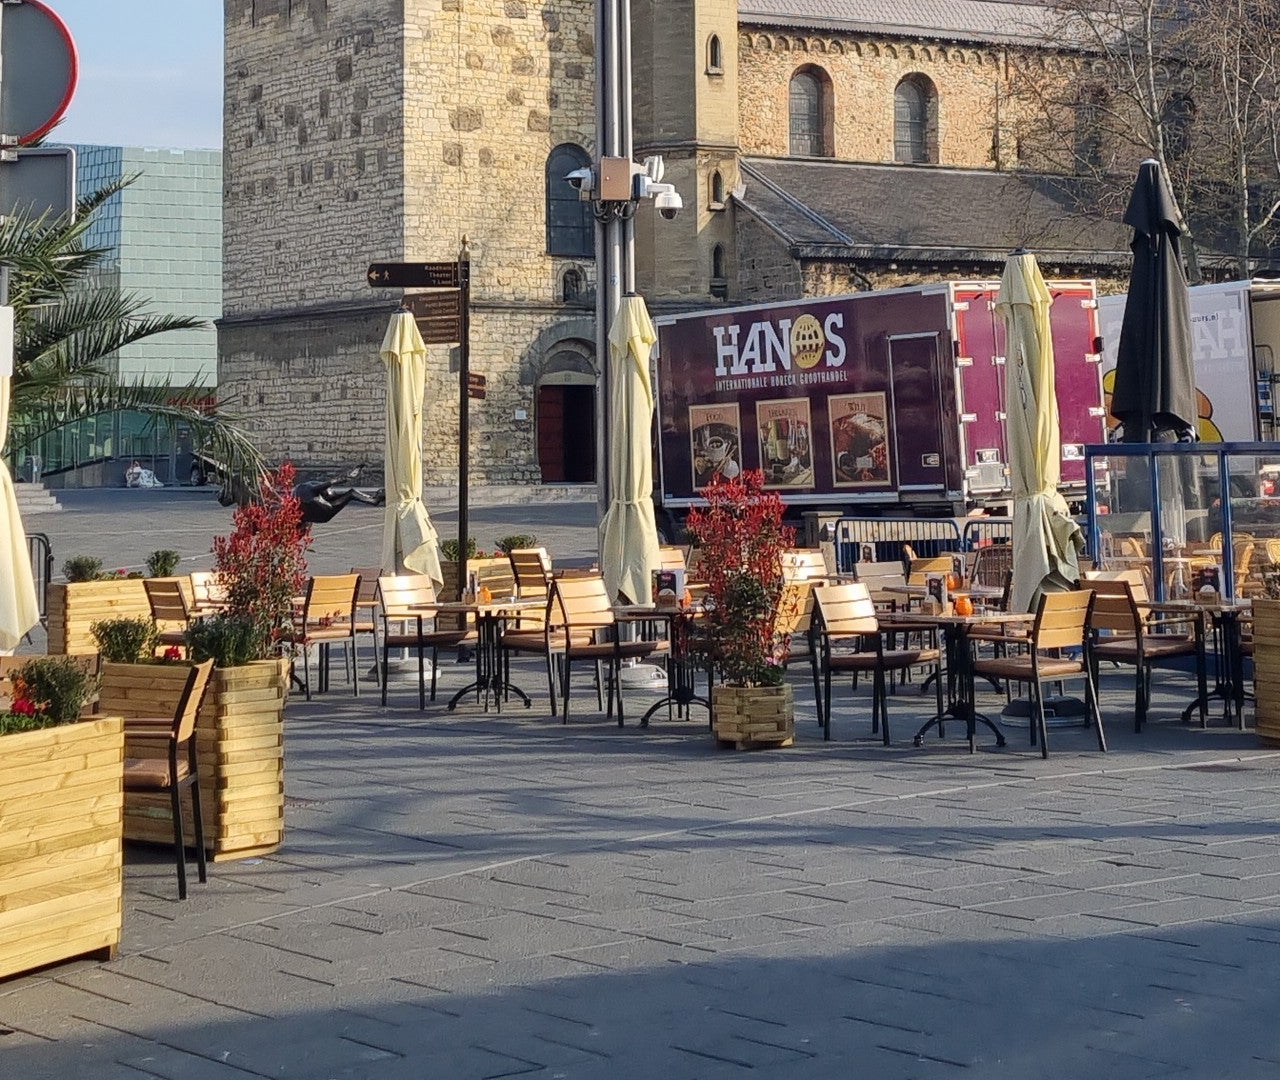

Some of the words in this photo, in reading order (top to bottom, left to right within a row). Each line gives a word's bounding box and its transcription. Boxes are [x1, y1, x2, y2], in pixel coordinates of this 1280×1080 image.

[713, 313, 847, 376] HANOS
[715, 376, 768, 392] INTERNATIONALE
[770, 374, 797, 387] HORECA
[800, 370, 848, 385] GROOTHANDEL
